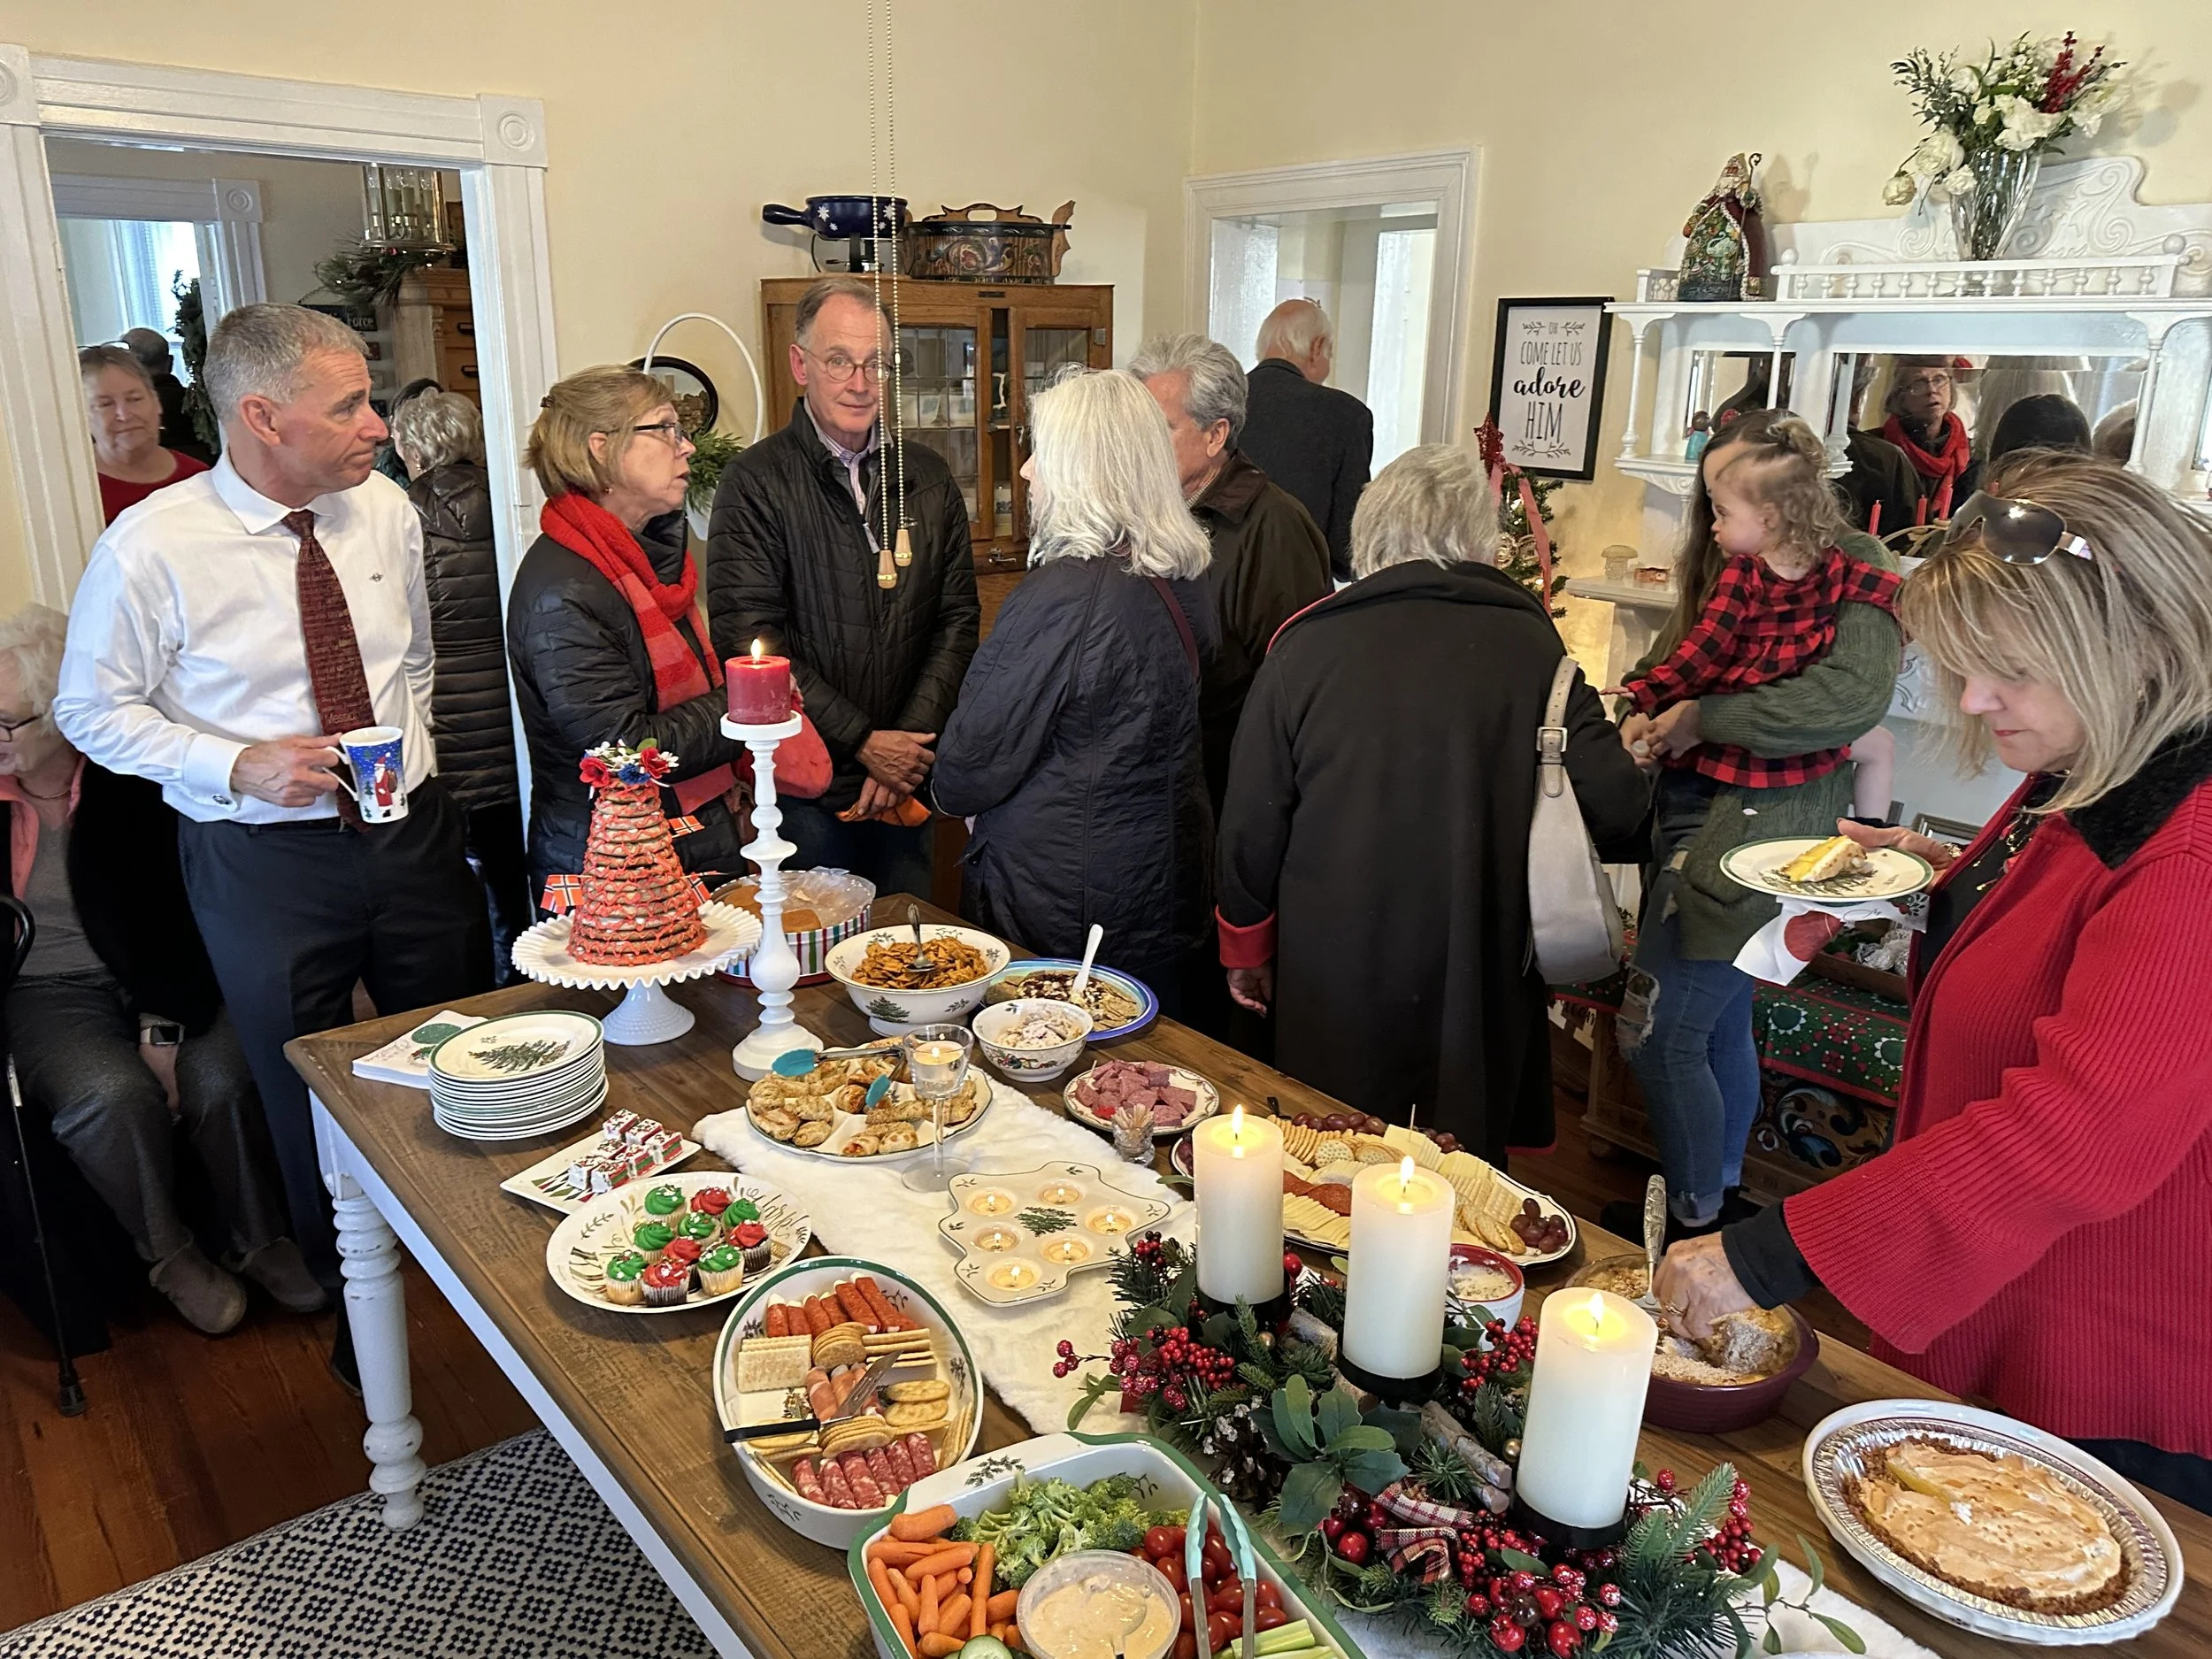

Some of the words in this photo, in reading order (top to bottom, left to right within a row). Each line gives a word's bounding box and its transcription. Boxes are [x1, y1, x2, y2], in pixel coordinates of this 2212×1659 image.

[1520, 341, 1548, 365] COME
[1551, 342, 1569, 365] LET
[1571, 342, 1583, 365] US
[1513, 366, 1586, 398] adore
[1525, 401, 1563, 443] HIM
